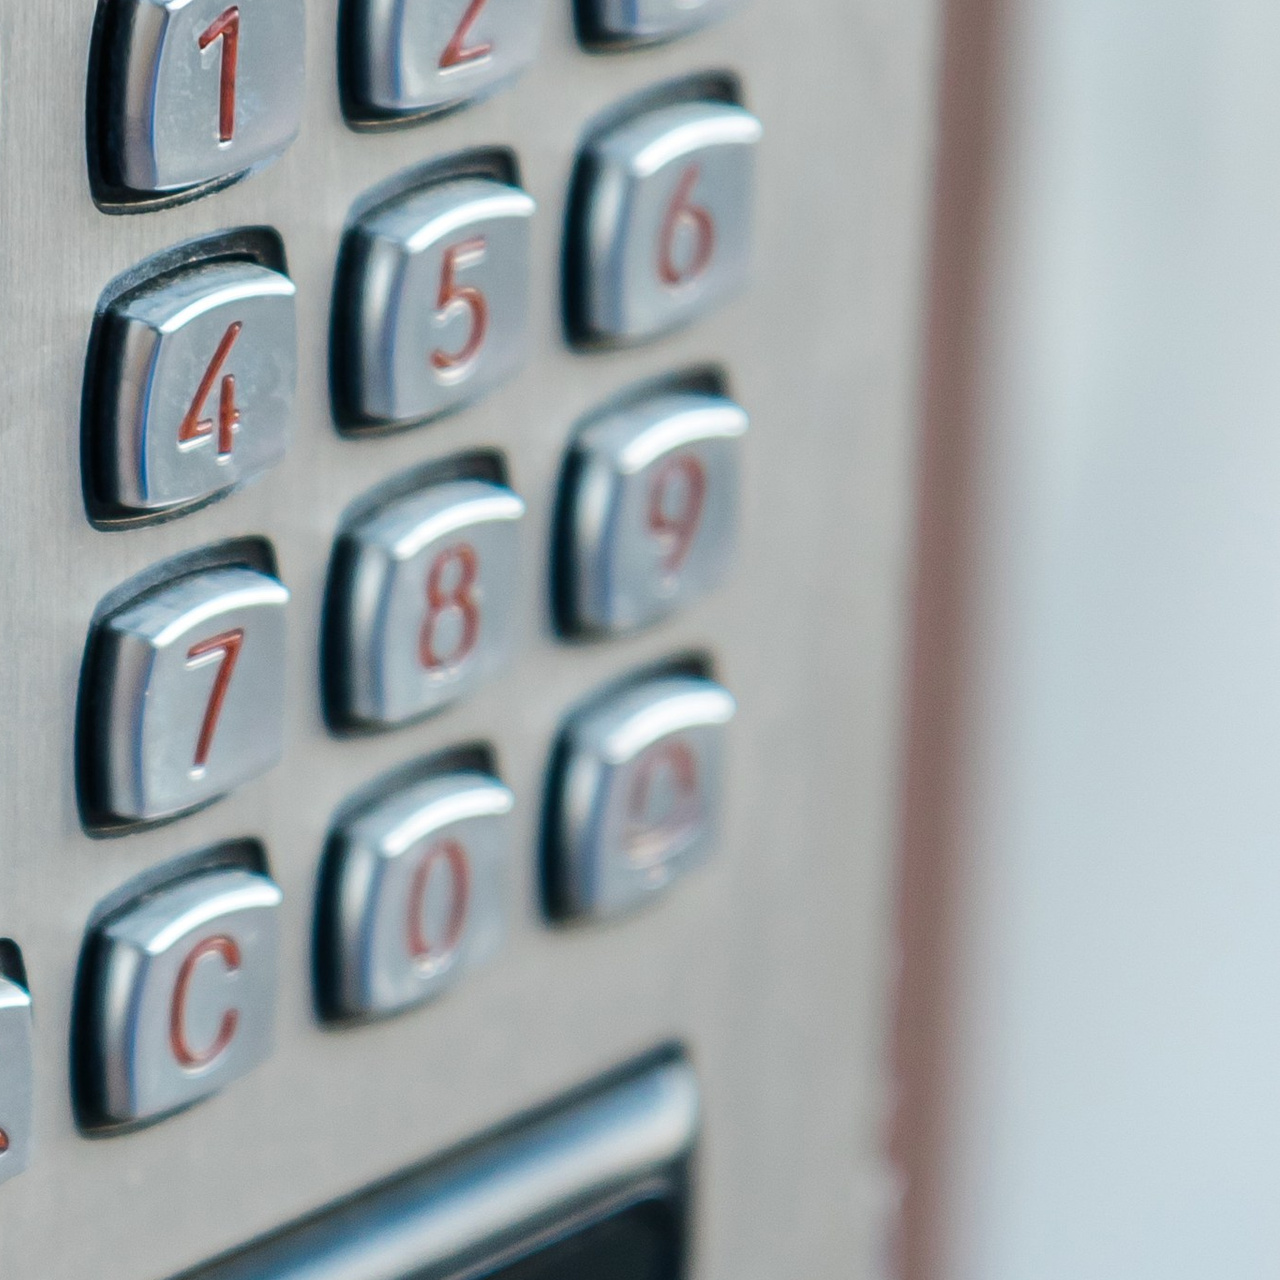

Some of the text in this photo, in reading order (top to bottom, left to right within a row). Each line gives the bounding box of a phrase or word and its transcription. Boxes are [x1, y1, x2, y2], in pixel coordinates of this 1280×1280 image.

[197, 4, 240, 145] 1
[177, 164, 715, 457] 4 5 6
[185, 454, 706, 780] 7 8 9
[406, 837, 471, 968] 0
